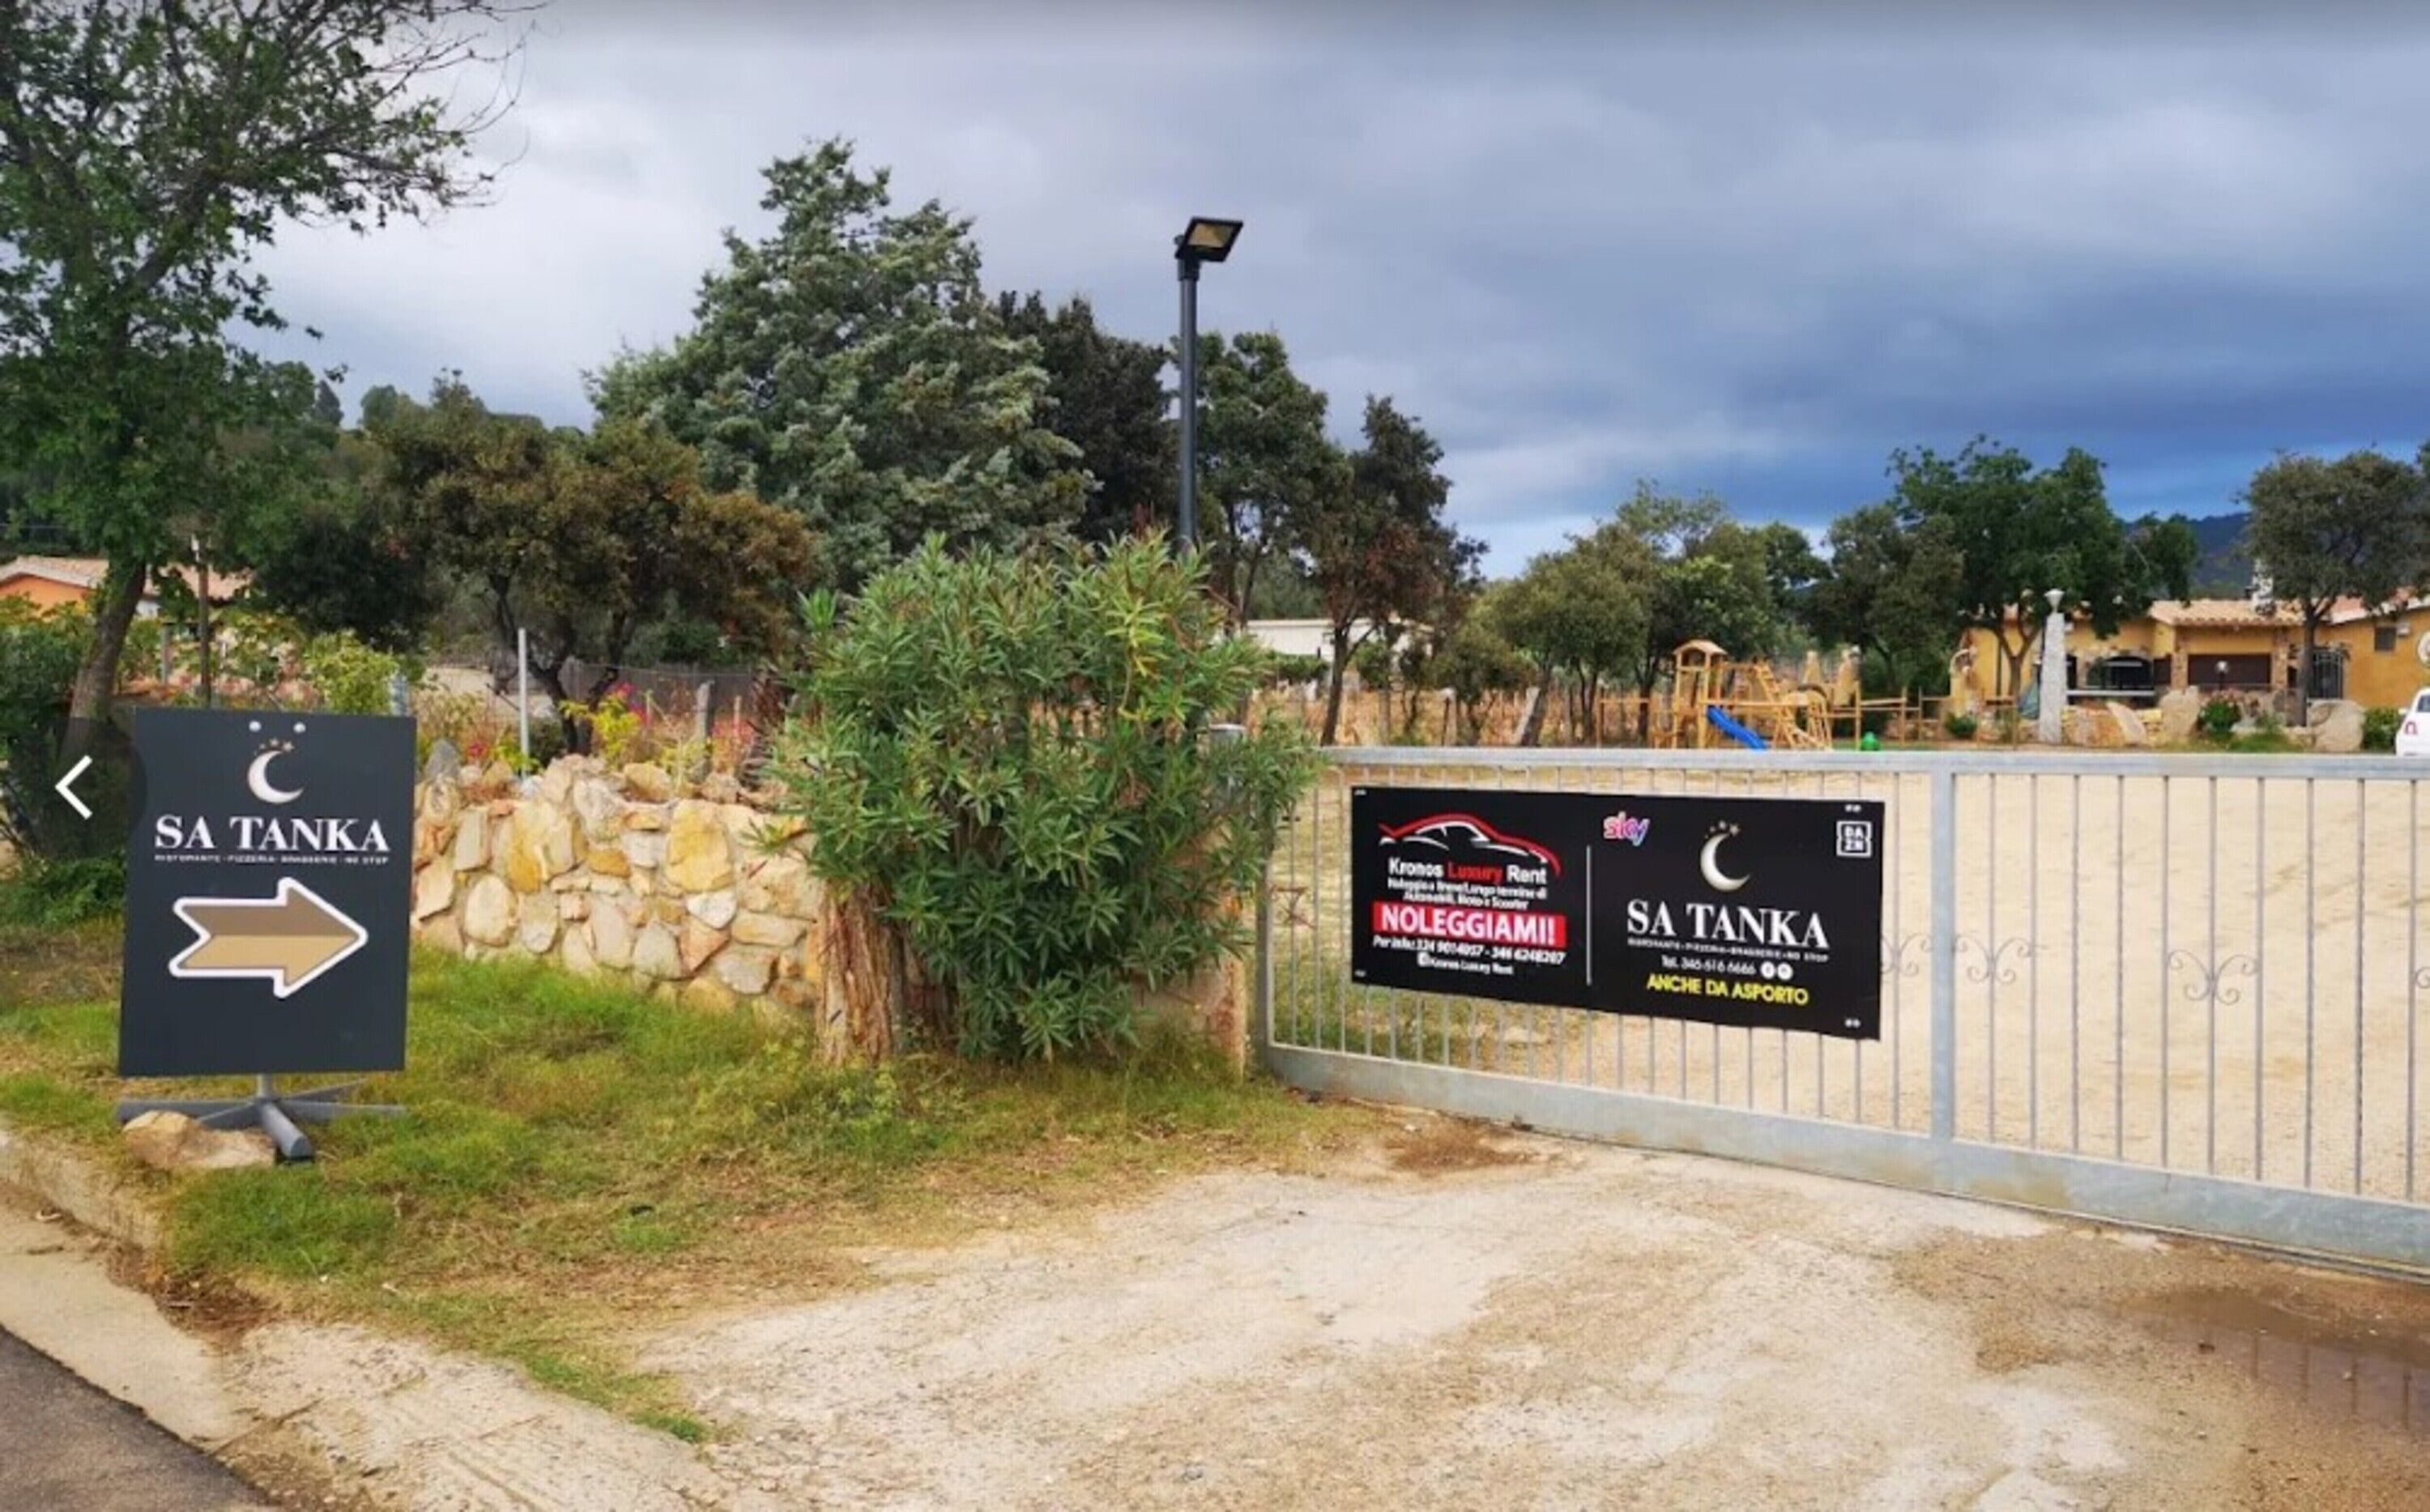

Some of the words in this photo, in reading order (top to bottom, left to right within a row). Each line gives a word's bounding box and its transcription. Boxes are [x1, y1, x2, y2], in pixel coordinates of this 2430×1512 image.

[155, 814, 216, 850] SA
[229, 816, 390, 852] TANKA
[1604, 811, 1650, 846] sky
[228, 854, 275, 864] PIZZERIA
[1388, 857, 1444, 877] Kronos
[1447, 862, 1503, 884] Luxury
[1507, 863, 1547, 884] Rent
[1382, 905, 1555, 946] NOLEGGIAMI!
[1626, 899, 1677, 937] SA
[1686, 901, 1830, 949] TANKA
[1661, 955, 1679, 969] Tel.
[1646, 973, 1702, 994] ANCHE
[1705, 978, 1728, 997] DA
[1732, 982, 1809, 1005] ASPORTO
